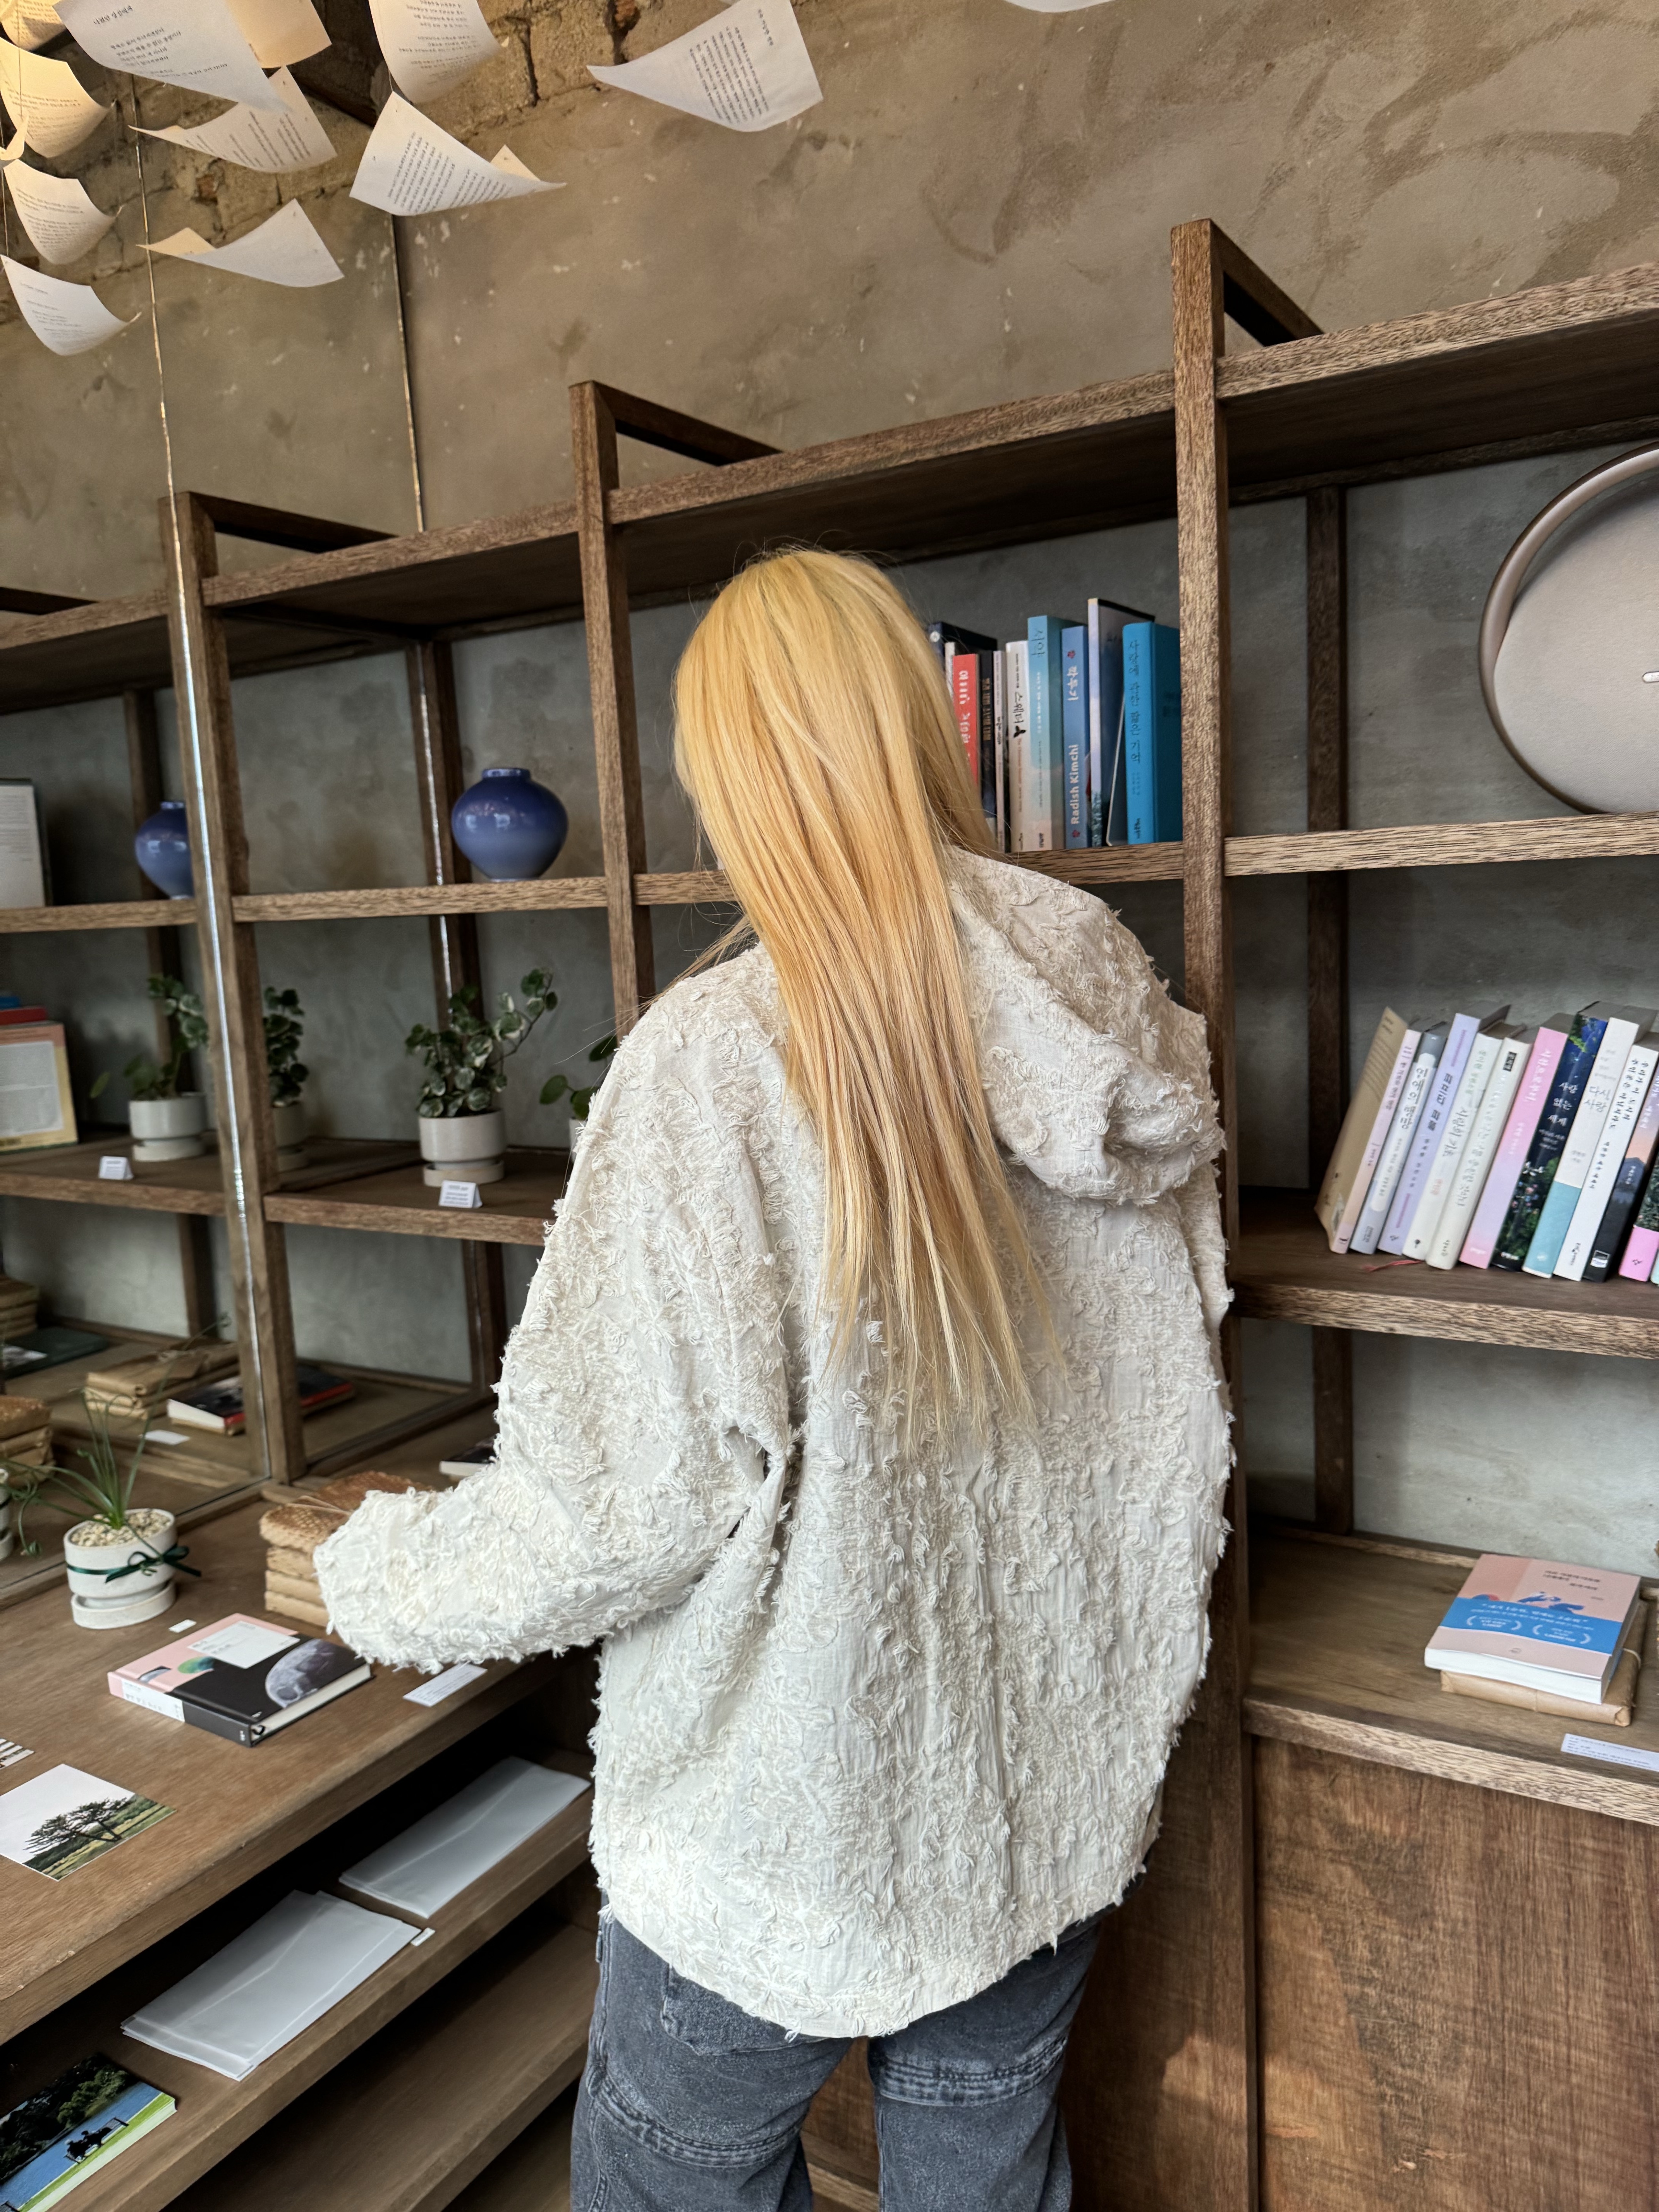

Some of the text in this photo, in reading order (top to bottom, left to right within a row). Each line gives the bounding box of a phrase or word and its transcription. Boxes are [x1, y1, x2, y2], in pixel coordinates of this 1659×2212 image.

[1068, 744, 1080, 825] Radish Kimchi
[1559, 1082, 1578, 1094] 사랑
[1553, 1098, 1573, 1111] 없는
[1583, 1101, 1607, 1112] 사랑
[1451, 1106, 1471, 1137] 사랑의
[1547, 1115, 1567, 1127] 세계
